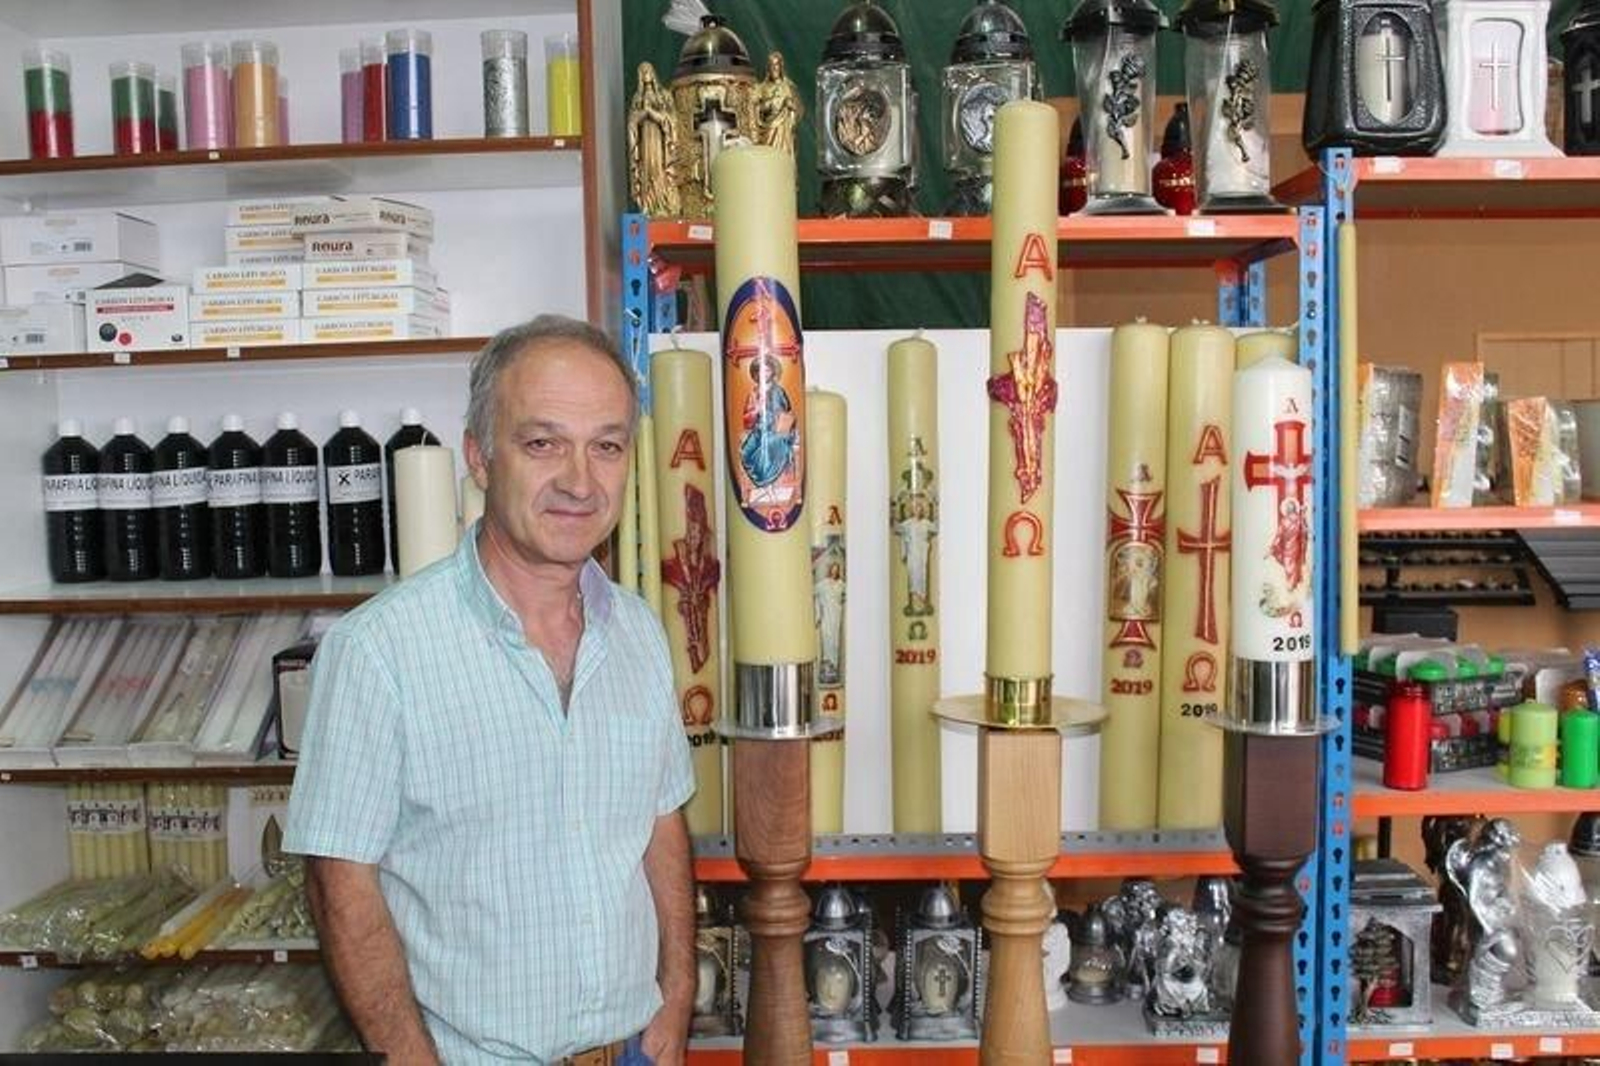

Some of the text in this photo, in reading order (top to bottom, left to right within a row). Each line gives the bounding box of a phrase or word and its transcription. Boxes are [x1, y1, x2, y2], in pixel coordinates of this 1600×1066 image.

[1015, 233, 1053, 282] A
[669, 428, 706, 472] A
[1193, 424, 1228, 466] A
[1002, 510, 1044, 559] Ω
[895, 649, 937, 664] 2019
[1182, 651, 1218, 693] Ω
[682, 685, 714, 727] Ω
[1110, 678, 1154, 695] 2019
